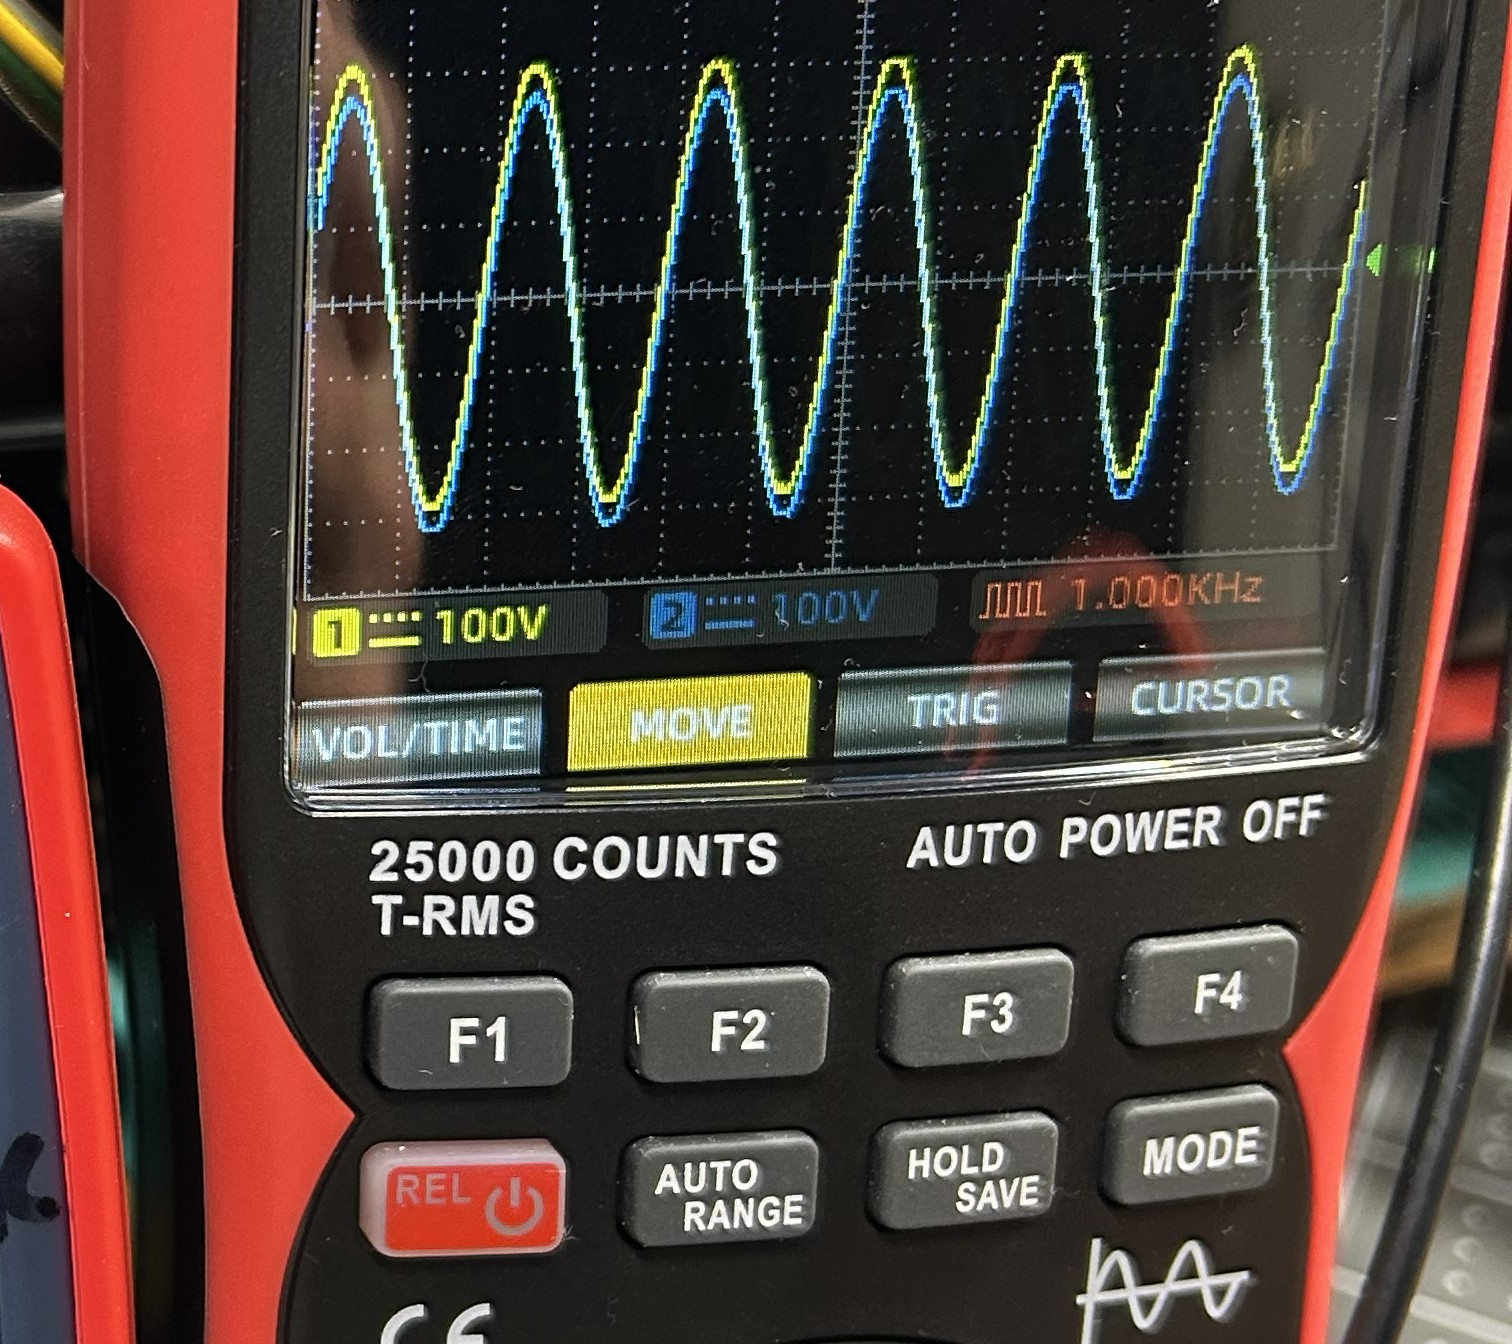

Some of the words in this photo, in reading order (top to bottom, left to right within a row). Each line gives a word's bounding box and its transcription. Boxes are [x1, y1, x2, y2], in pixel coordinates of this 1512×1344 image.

[436, 603, 548, 646] 100V
[771, 588, 881, 626] 100V
[1071, 571, 1265, 612] 1.000KHz
[311, 715, 527, 762] VOL/TIME
[630, 703, 753, 745] MOVE
[907, 690, 1000, 729] TRIG
[1130, 674, 1292, 717] CURSOR
[369, 839, 536, 883] 25000
[553, 832, 781, 881] COUNTS
[906, 819, 1039, 870] AUTO
[1059, 805, 1224, 860] POWER
[1242, 793, 1330, 843] OFF
[371, 894, 536, 936] T-RMS
[448, 1016, 509, 1064] F1
[710, 1009, 769, 1053] F2
[961, 991, 1015, 1036] F3
[1194, 970, 1244, 1014] F4
[395, 1171, 471, 1205] REL
[654, 1158, 758, 1196] AUTO
[907, 1141, 1005, 1181] HOLD
[1142, 1125, 1262, 1177] MODE
[683, 1193, 805, 1232] RANGE
[954, 1174, 1041, 1214] SAVE
